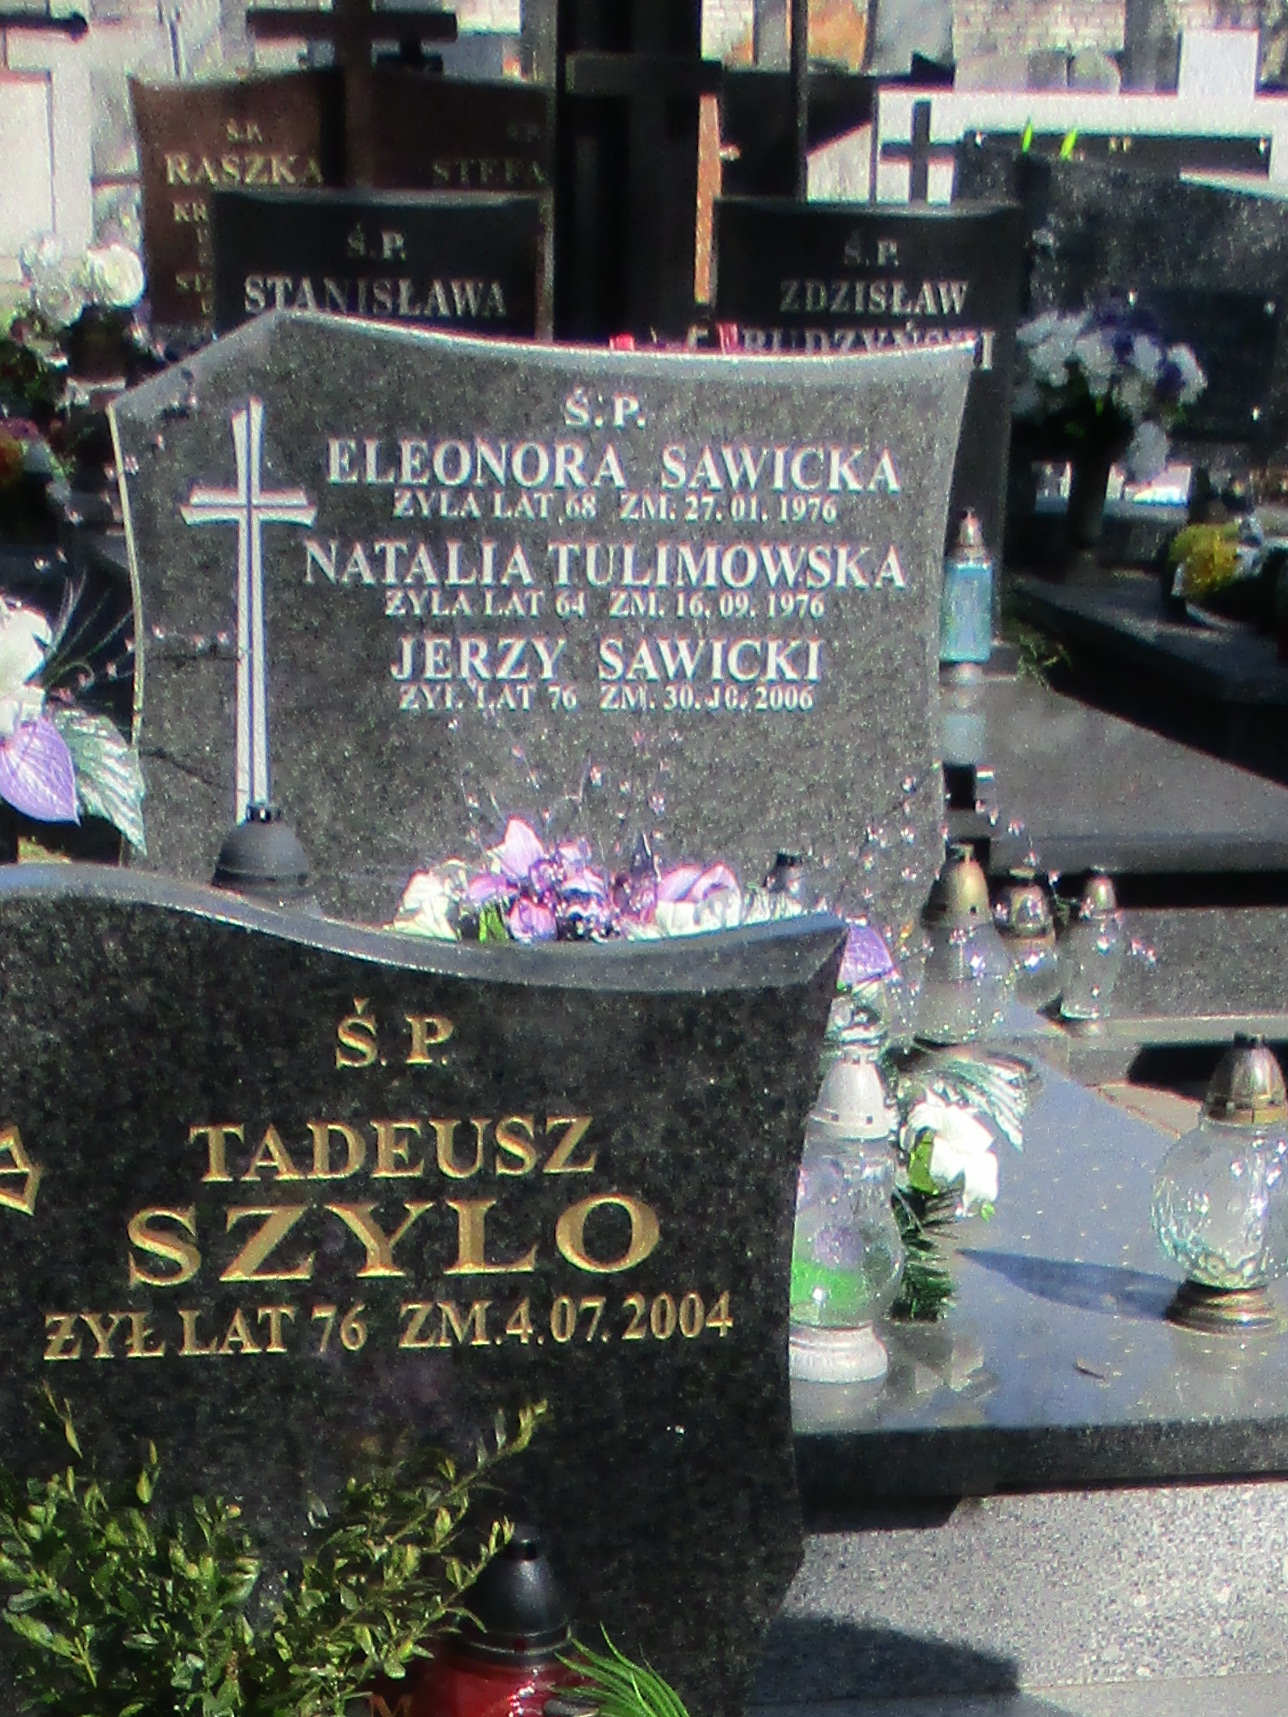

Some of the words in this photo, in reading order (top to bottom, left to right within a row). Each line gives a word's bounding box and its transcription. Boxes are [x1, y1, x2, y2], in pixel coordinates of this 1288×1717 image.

[165, 153, 324, 186] RASZKA
[324, 437, 627, 488] ELEONORA
[660, 444, 902, 494] SAWICKA
[493, 489, 555, 522] LAT
[565, 491, 597, 520] 68
[778, 494, 838, 525] 1976
[303, 538, 535, 588] NATALIA
[546, 540, 908, 591] TULIMOWSKA
[485, 588, 545, 619] LAT
[555, 590, 586, 620] 64
[767, 591, 826, 621] 1976
[390, 634, 569, 682] JERZY
[597, 635, 825, 684] SAWICKI
[476, 682, 538, 713] LAT
[547, 684, 578, 712] 76
[754, 684, 815, 714] 2006
[187, 1115, 600, 1183] TADEUSZ
[178, 1307, 298, 1356] LAT
[311, 1300, 368, 1353] 76
